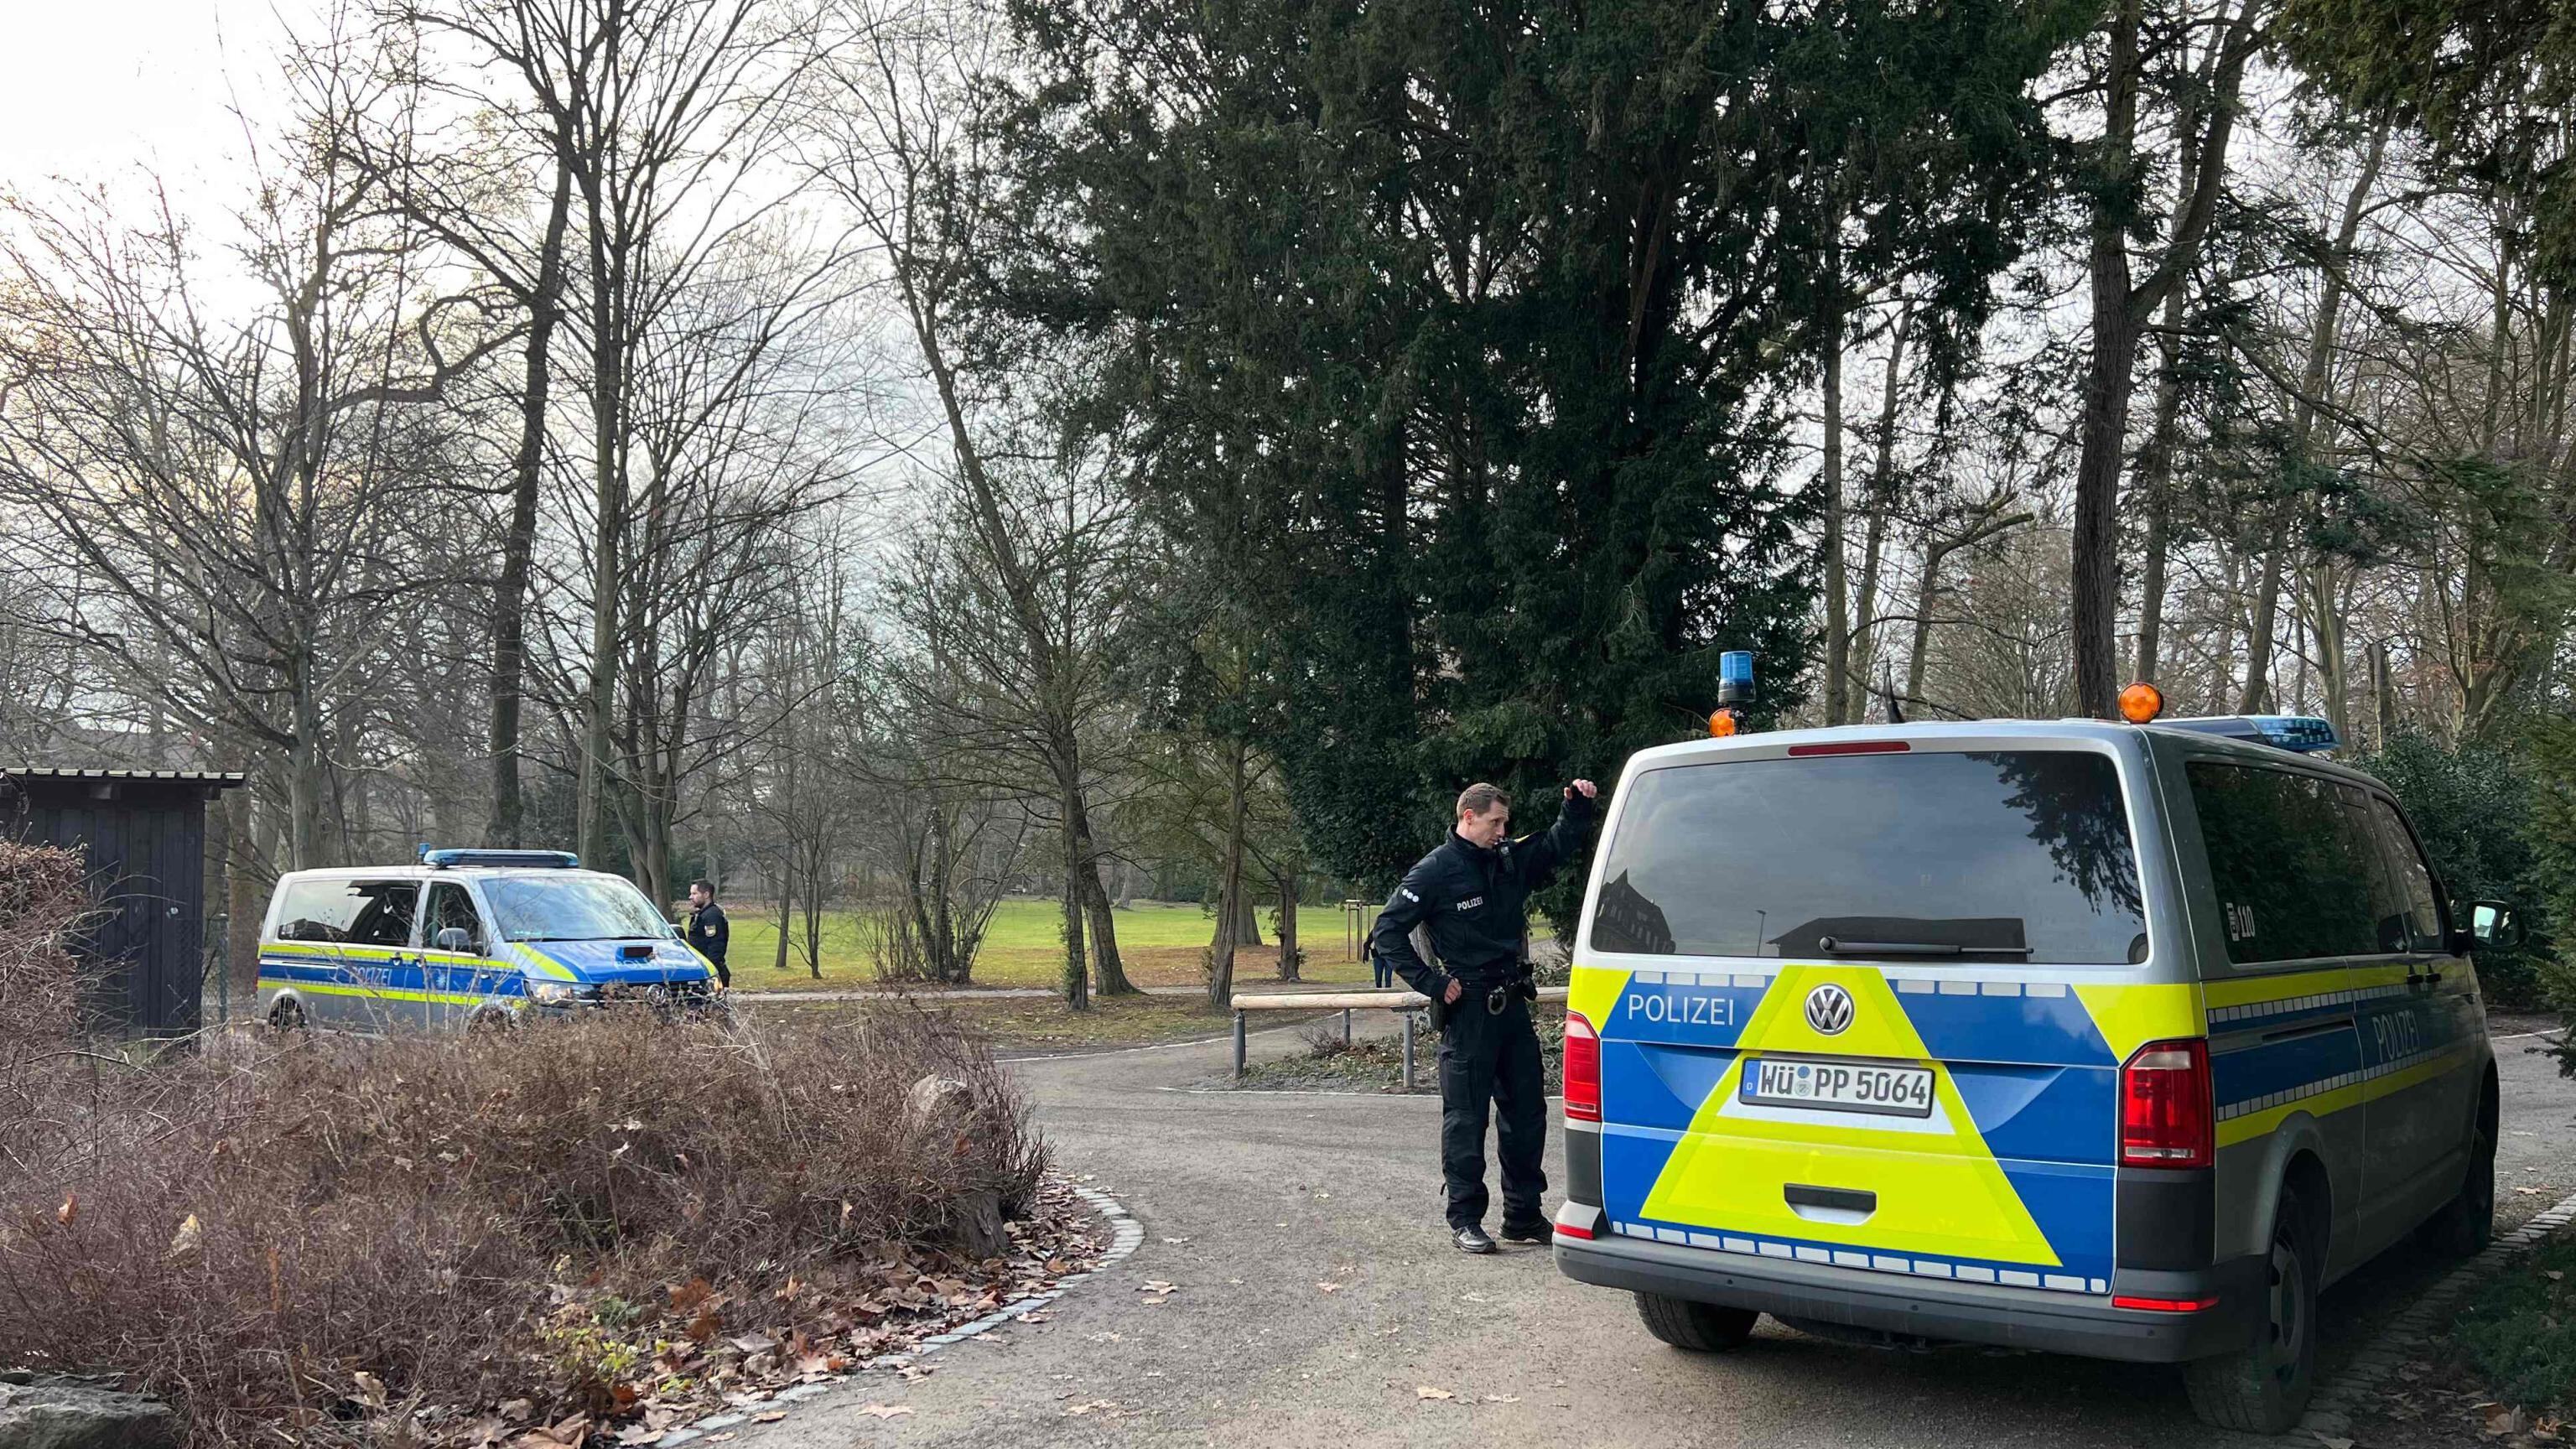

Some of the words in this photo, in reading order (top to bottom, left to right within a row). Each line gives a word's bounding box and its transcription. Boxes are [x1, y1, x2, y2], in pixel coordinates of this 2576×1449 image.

[1457, 896, 1483, 911] POLIZEI
[2237, 905, 2255, 937] 110
[1628, 994, 1734, 1026] POLIZEI
[2371, 1009, 2420, 1063] POLIZEI
[1762, 1065, 1794, 1095] WÜ
[1814, 1067, 1849, 1098] PP
[1855, 1071, 1926, 1105] 5064
